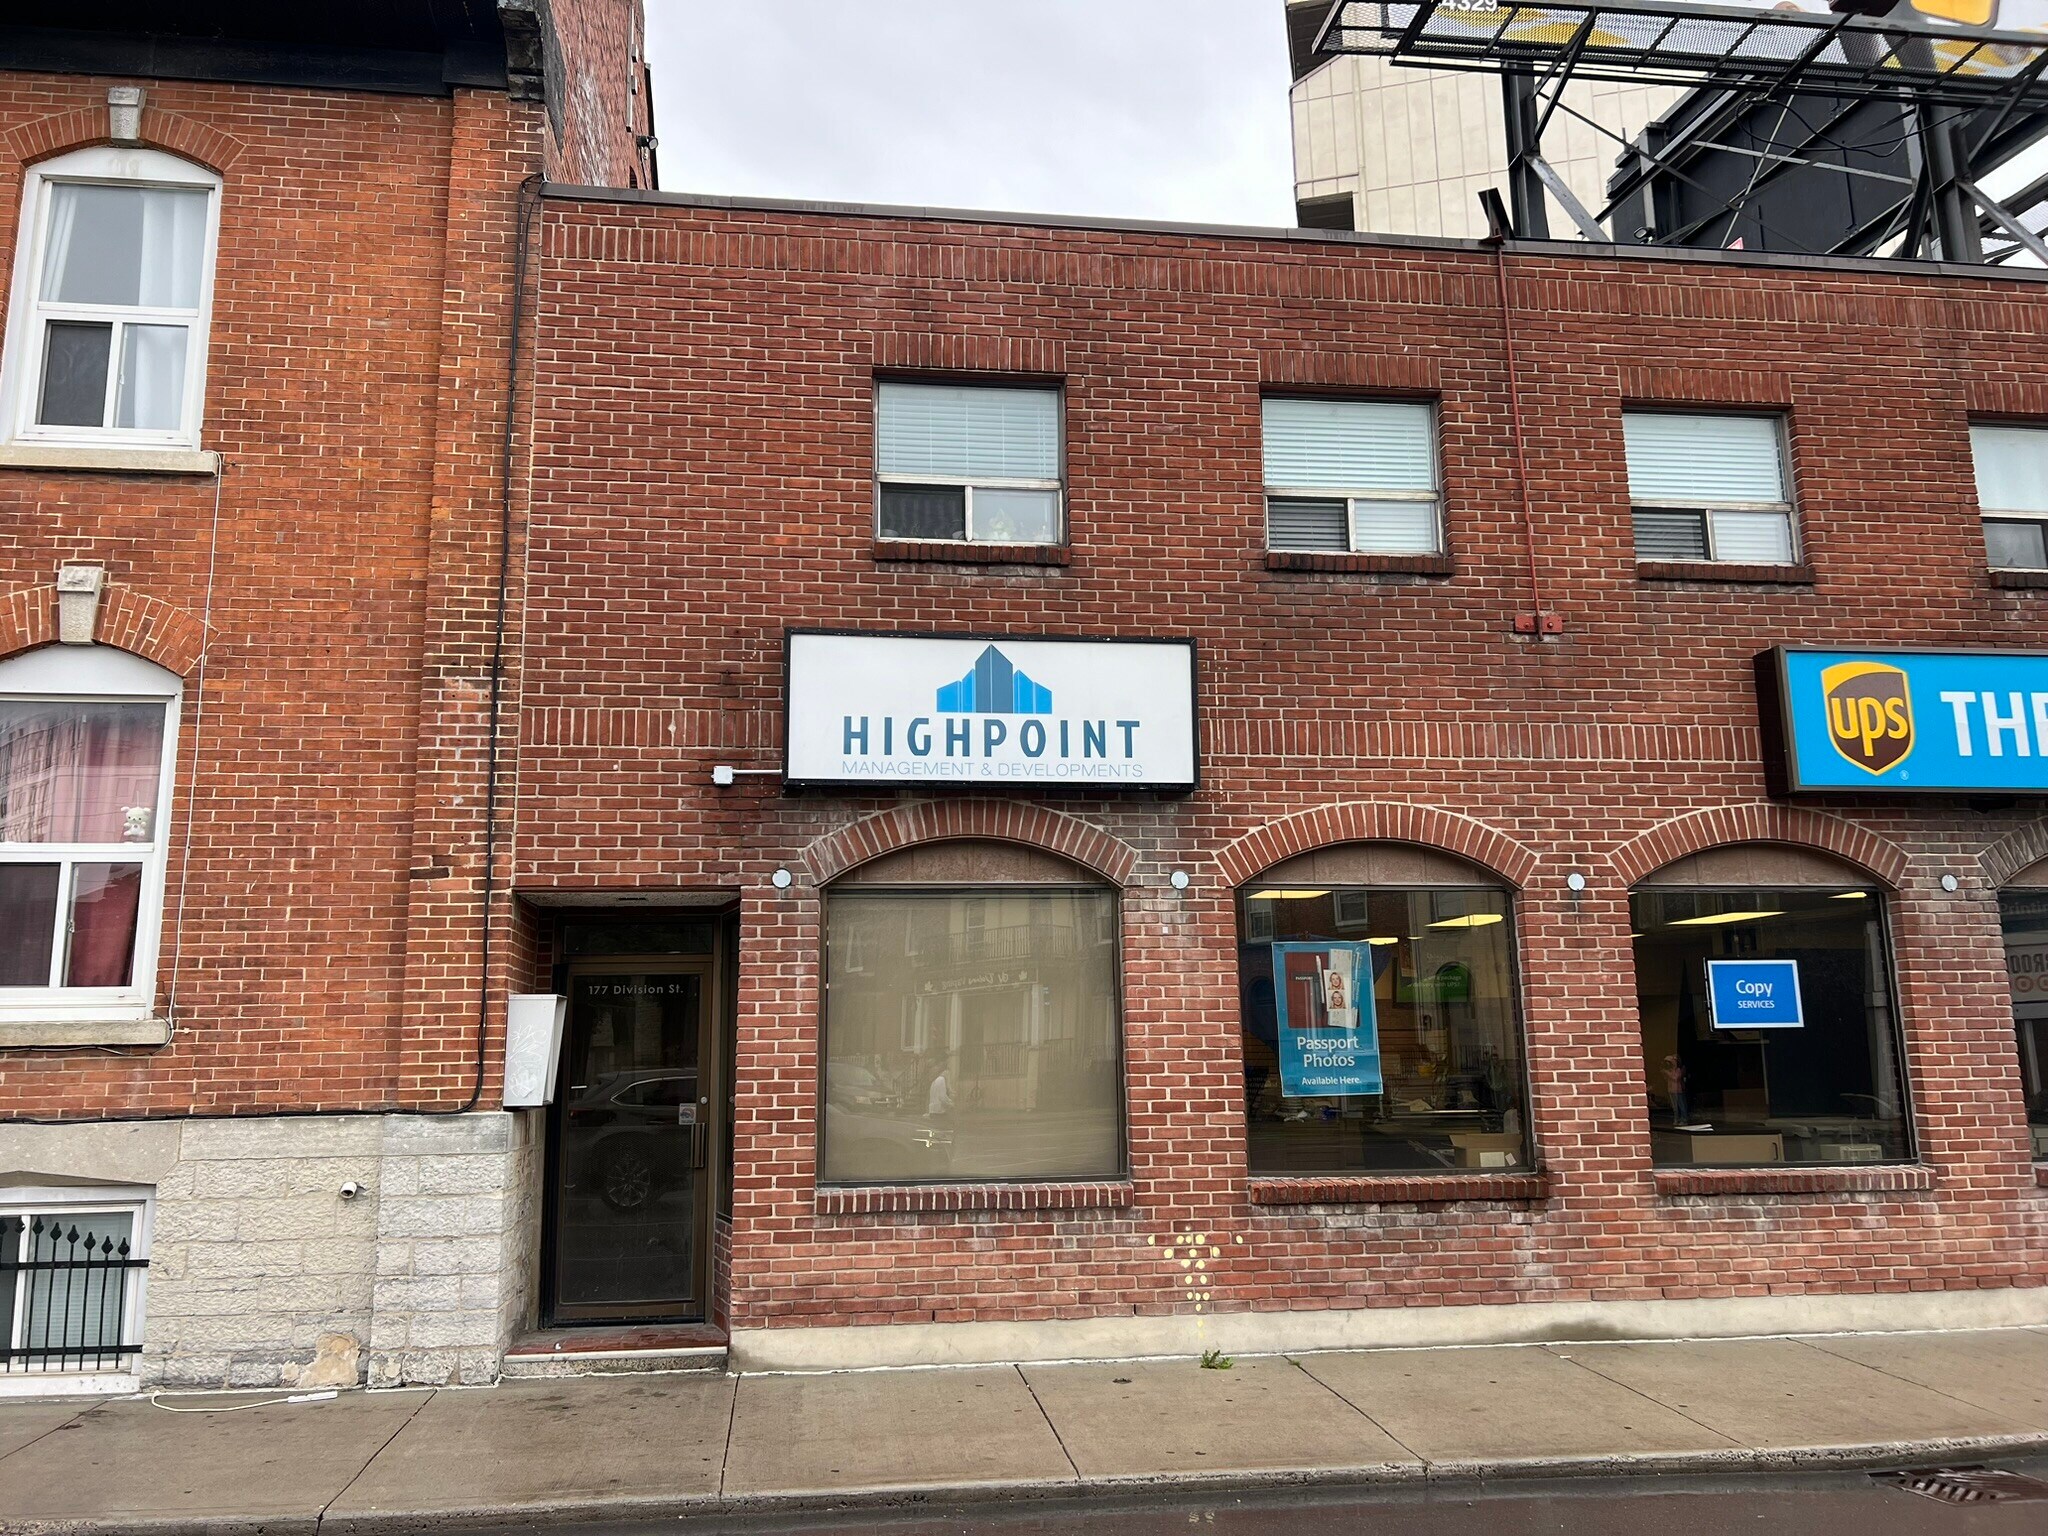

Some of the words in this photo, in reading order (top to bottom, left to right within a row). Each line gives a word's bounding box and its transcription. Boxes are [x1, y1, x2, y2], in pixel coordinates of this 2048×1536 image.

[1831, 696, 1909, 756] ups
[843, 715, 1140, 758] HIGHPOINT
[842, 760, 974, 777] MANAGEMENT
[981, 764, 993, 777] &
[998, 762, 1143, 778] DEVELOPMENTS
[588, 985, 609, 995] 177
[613, 984, 664, 995] Division
[668, 984, 684, 994] St.
[1735, 979, 1773, 997] Copy
[1737, 1000, 1775, 1009] SERVICES
[1297, 1036, 1360, 1053] Passport
[1303, 1053, 1356, 1068] Photos
[1301, 1076, 1339, 1086] Available
[1339, 1075, 1363, 1085] Here.
